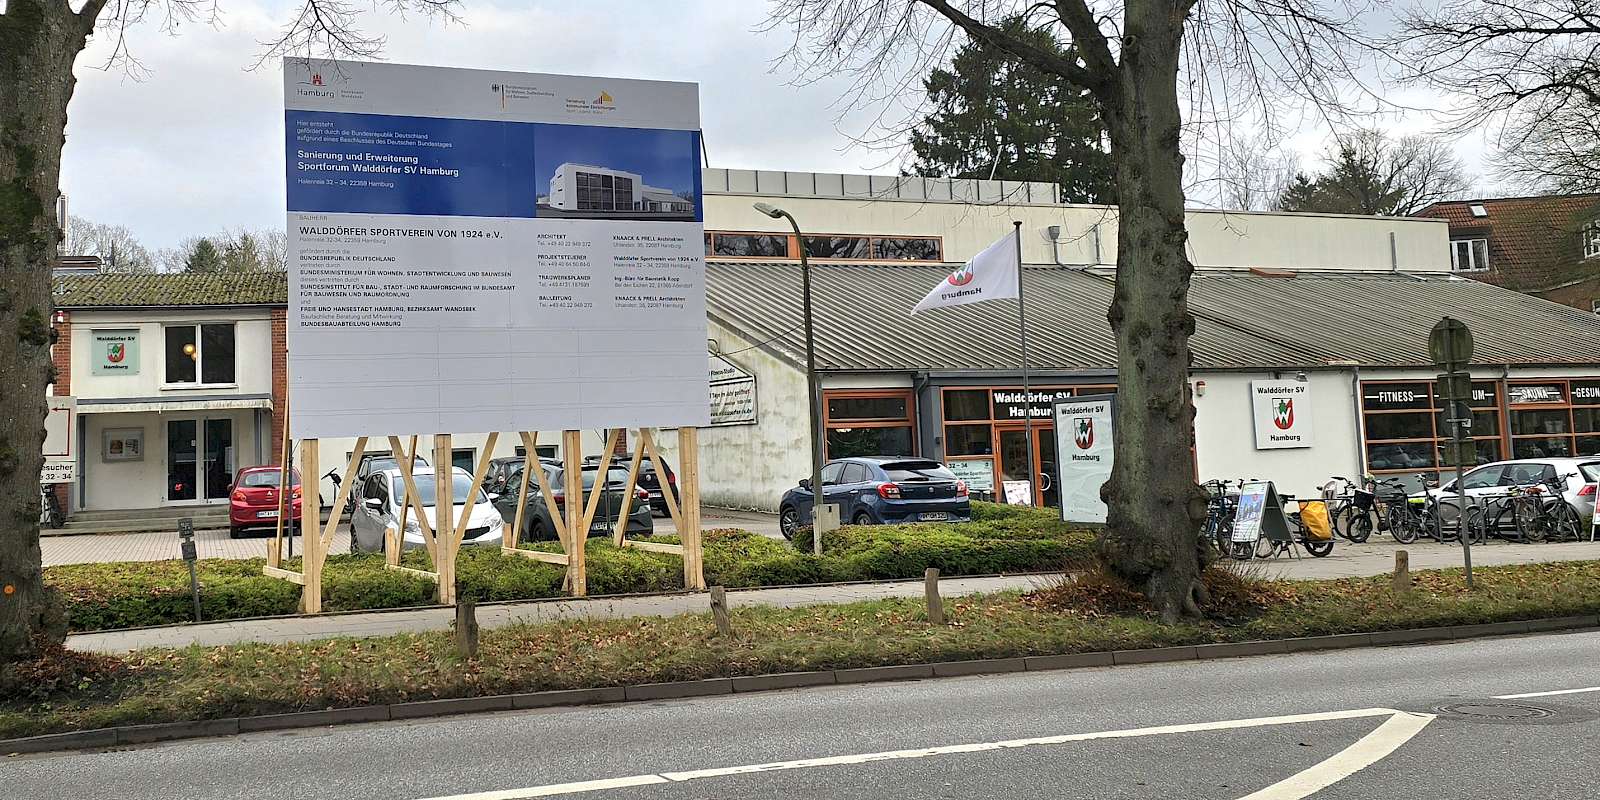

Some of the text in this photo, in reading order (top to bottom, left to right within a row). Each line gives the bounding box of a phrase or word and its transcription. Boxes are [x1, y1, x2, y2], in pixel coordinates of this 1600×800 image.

[297, 88, 335, 99] Hamburg
[351, 130, 393, 138] Bundesrepublik
[417, 140, 452, 148] Bundestages
[298, 150, 343, 162] Sanierung
[365, 153, 418, 164] Erweiterung
[298, 161, 350, 171] Sportforum
[352, 164, 402, 174] Walddörfer
[420, 166, 459, 177] Hamburg
[299, 225, 367, 236] WALDDÖRFER
[370, 228, 434, 237] SPORTVEREIN
[437, 229, 457, 238] VON
[1378, 390, 1414, 402] FITNESS
[1521, 388, 1549, 399] SAUNA
[1009, 406, 1053, 417] Hambur
[1061, 406, 1094, 415] Walddörfer
